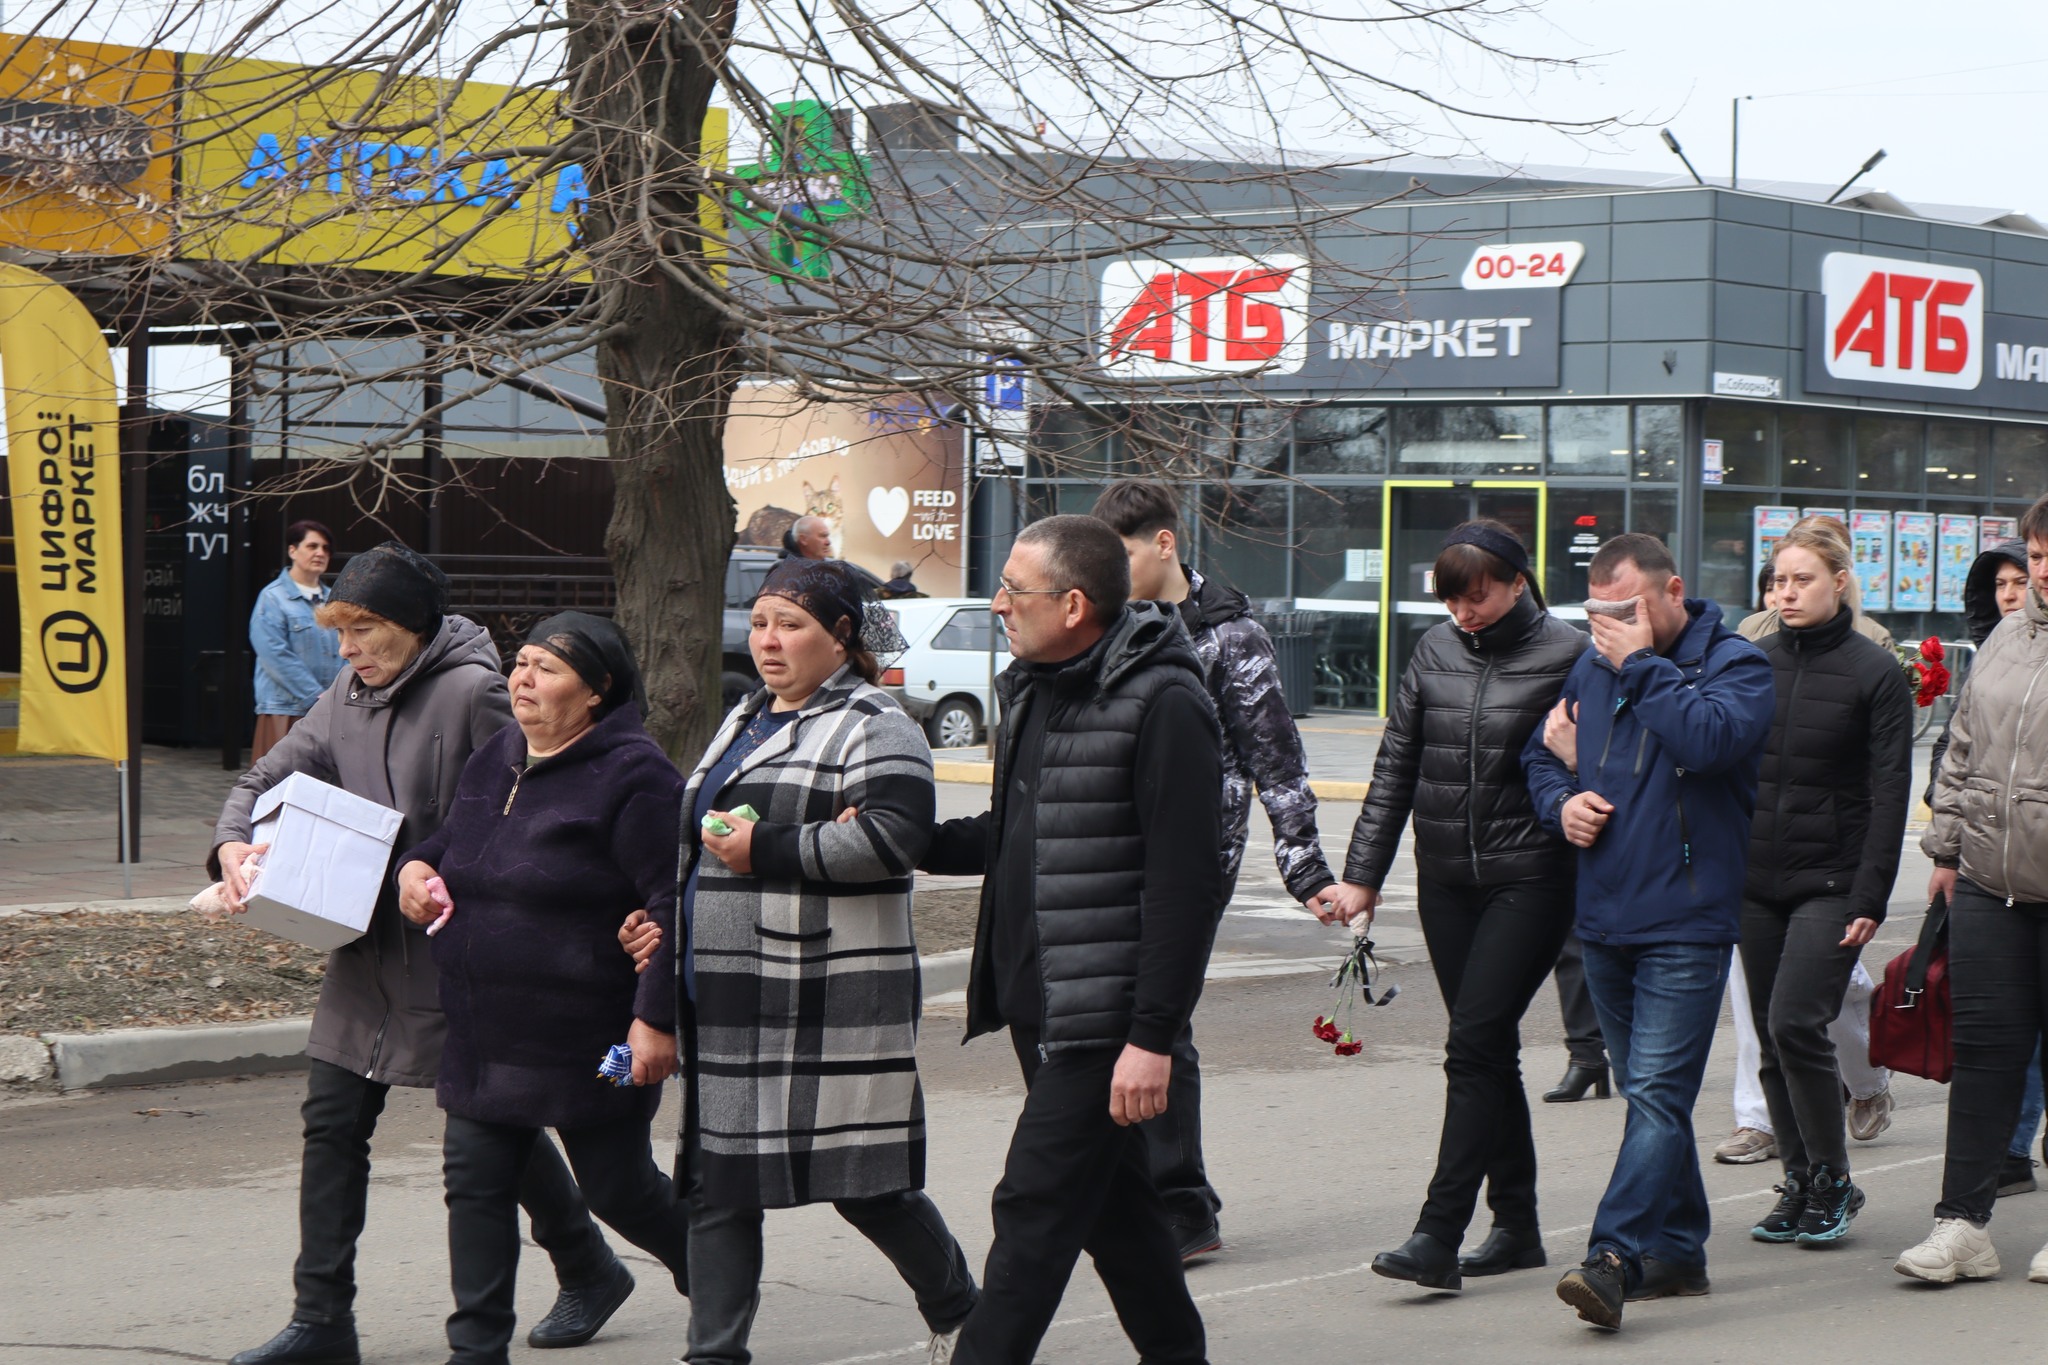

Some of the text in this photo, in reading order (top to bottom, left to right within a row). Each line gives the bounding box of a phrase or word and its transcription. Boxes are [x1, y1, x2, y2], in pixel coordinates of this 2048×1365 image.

[241, 133, 521, 208] АПТЕКА
[1475, 253, 1565, 279] 00-24
[1110, 268, 1293, 363] АТБ
[1834, 270, 1975, 375] АТБ
[1327, 317, 1532, 361] МАРКЕТ
[1996, 342, 2048, 383] МА
[69, 414, 96, 594] МАРКЕТ
[913, 490, 956, 507] FEED
[912, 523, 960, 540] LOVE
